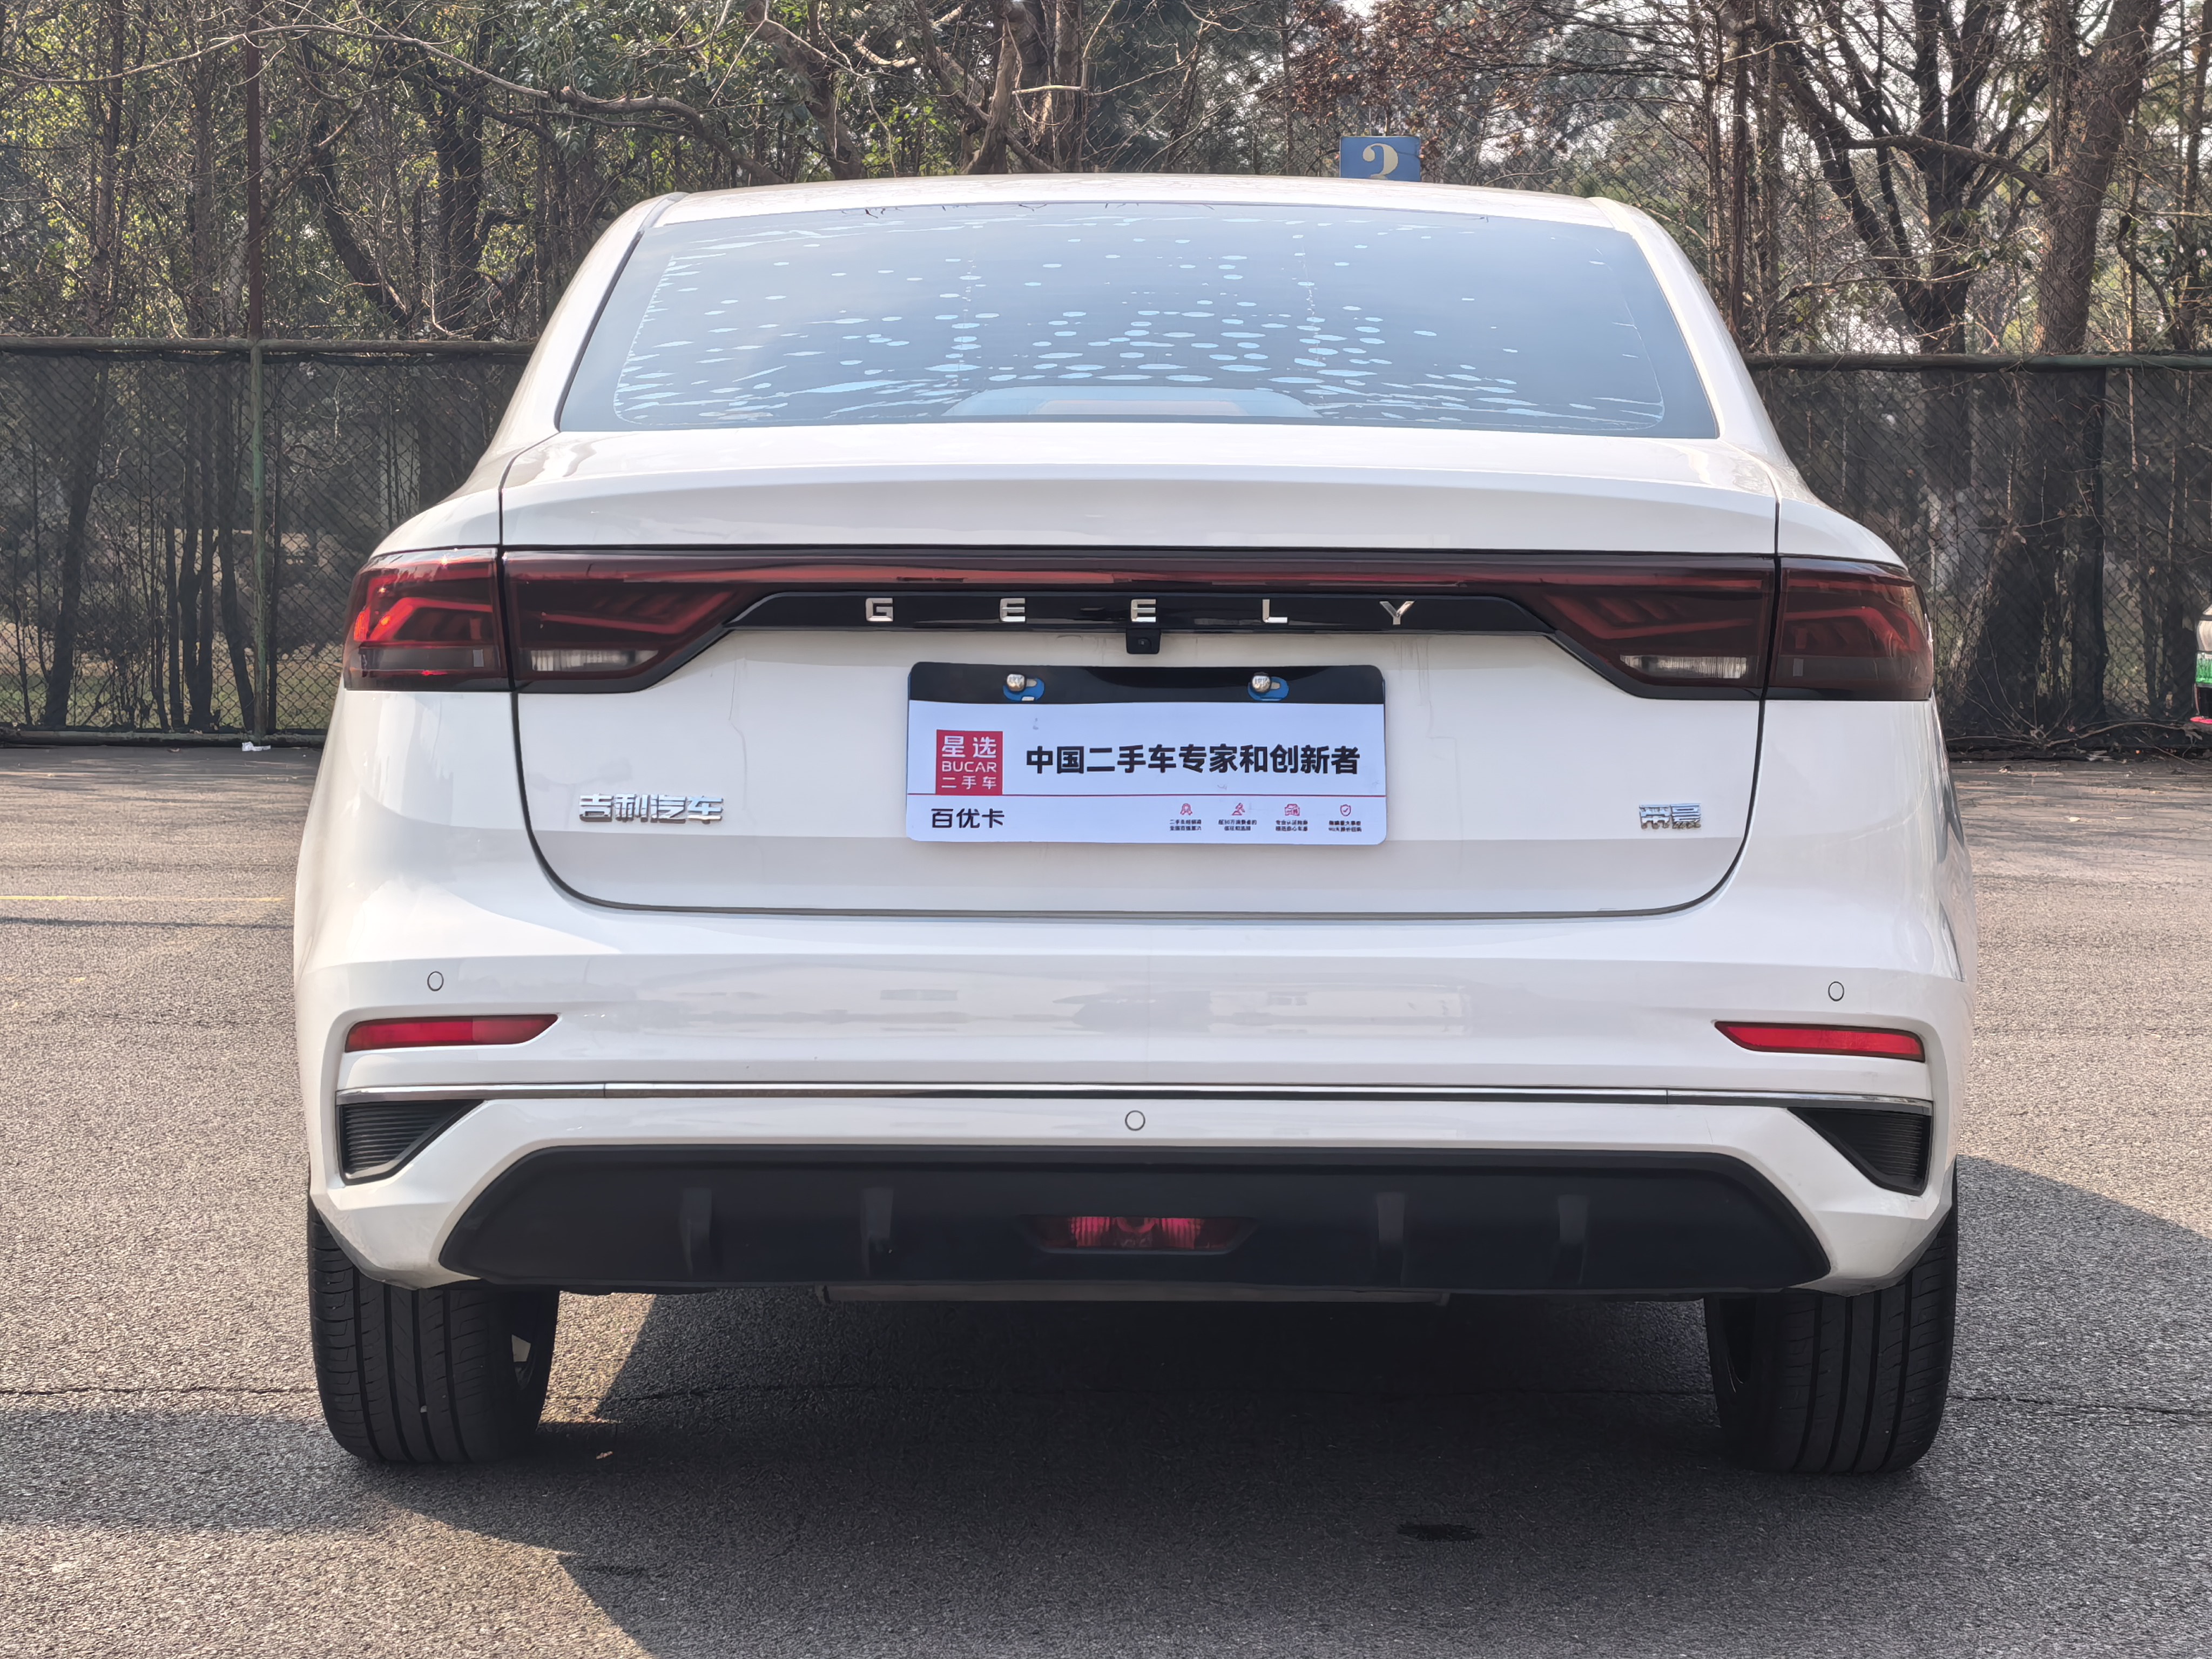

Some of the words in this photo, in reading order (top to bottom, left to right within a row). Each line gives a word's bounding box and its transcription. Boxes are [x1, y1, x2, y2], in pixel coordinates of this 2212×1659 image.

[1363, 143, 1399, 179] 2
[865, 597, 1414, 625] GEELY
[942, 736, 997, 758] 星选
[1026, 743, 1360, 774] 中国二手车专家和创新者
[942, 760, 997, 773] BUCAR
[941, 775, 997, 790] 二手车
[579, 793, 724, 824] 吉利汽车
[931, 808, 1005, 828] 百优卡
